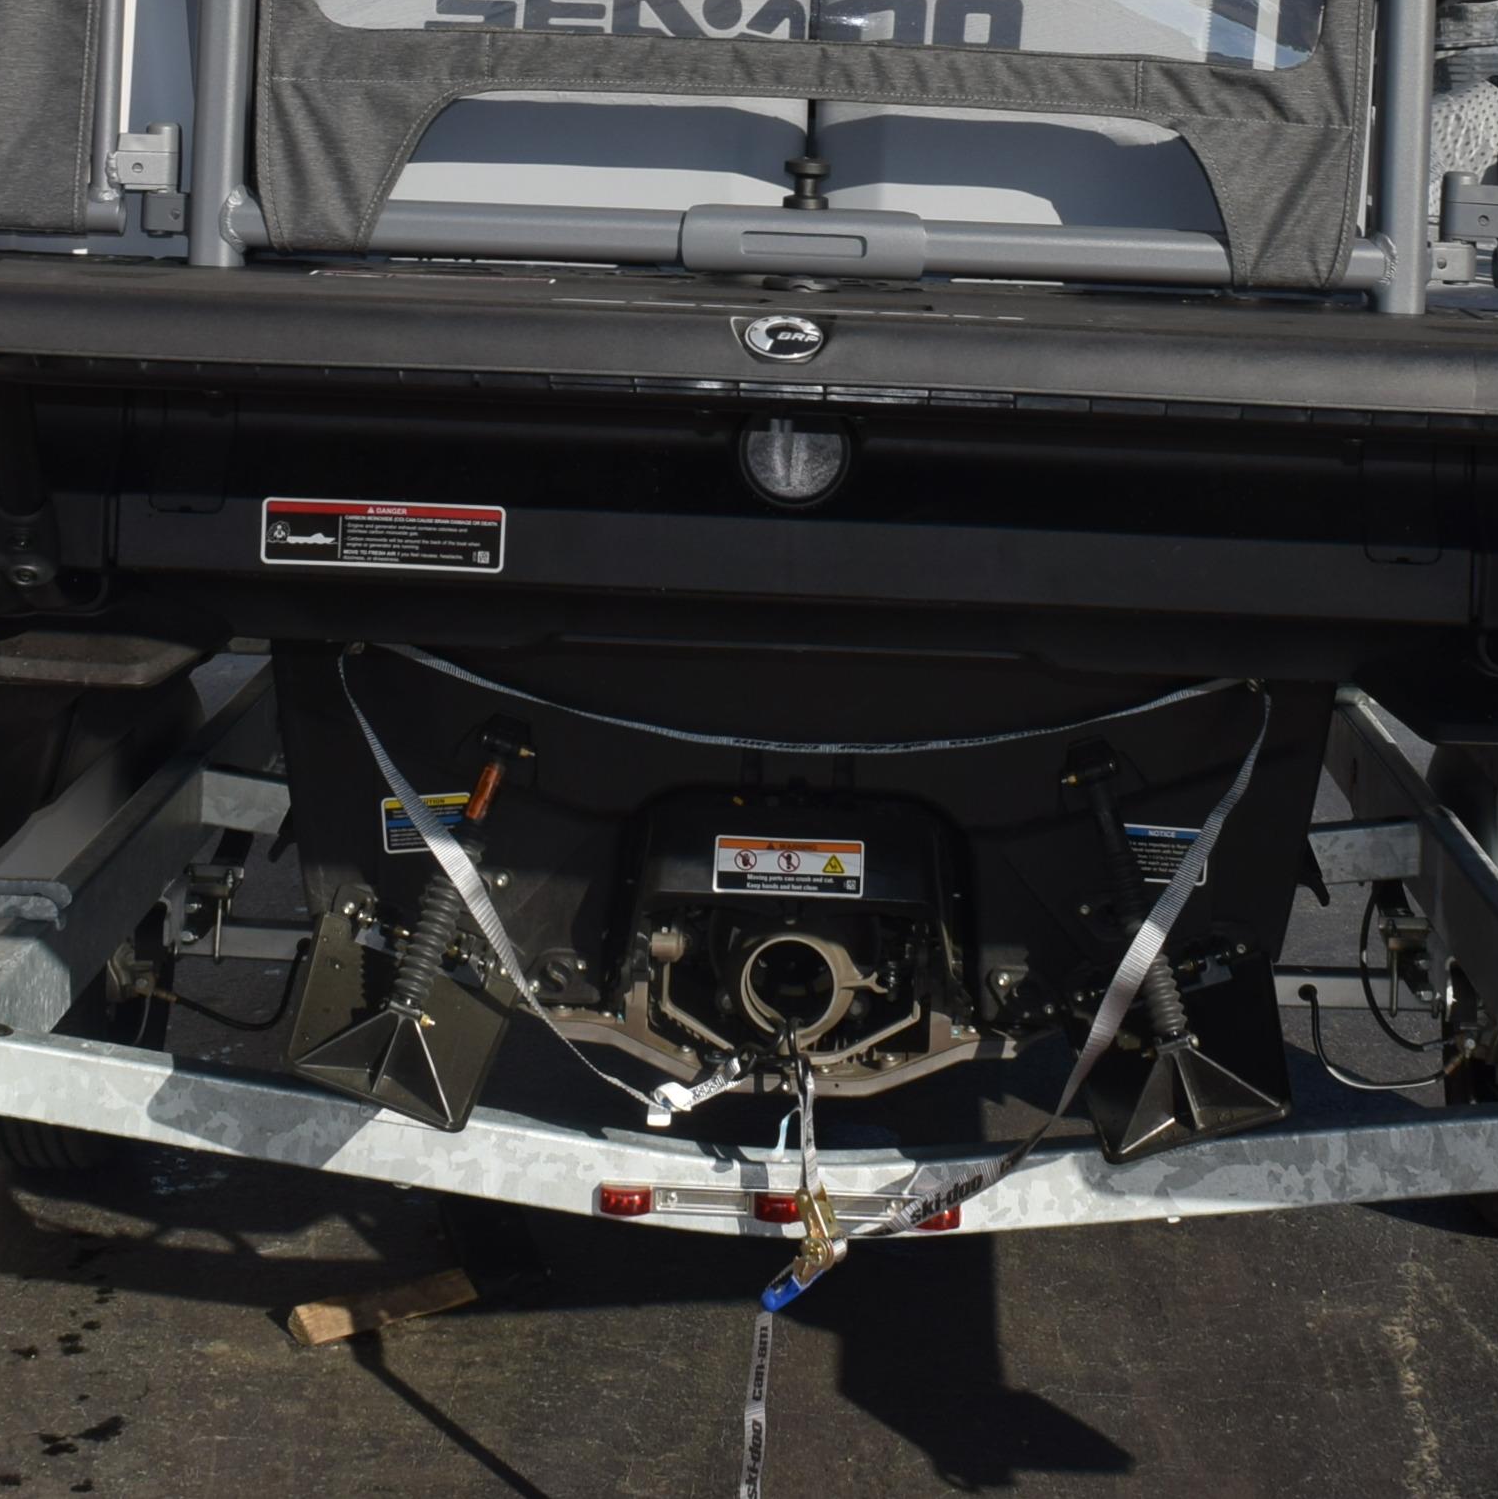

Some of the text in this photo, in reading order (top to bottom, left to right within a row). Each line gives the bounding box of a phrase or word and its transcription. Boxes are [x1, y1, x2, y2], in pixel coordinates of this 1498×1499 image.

[777, 331, 820, 342] BRP
[375, 507, 407, 515] DANGER
[1148, 830, 1176, 838] NOTICE
[910, 1174, 983, 1224] ski-doo
[752, 1326, 768, 1401] can-am
